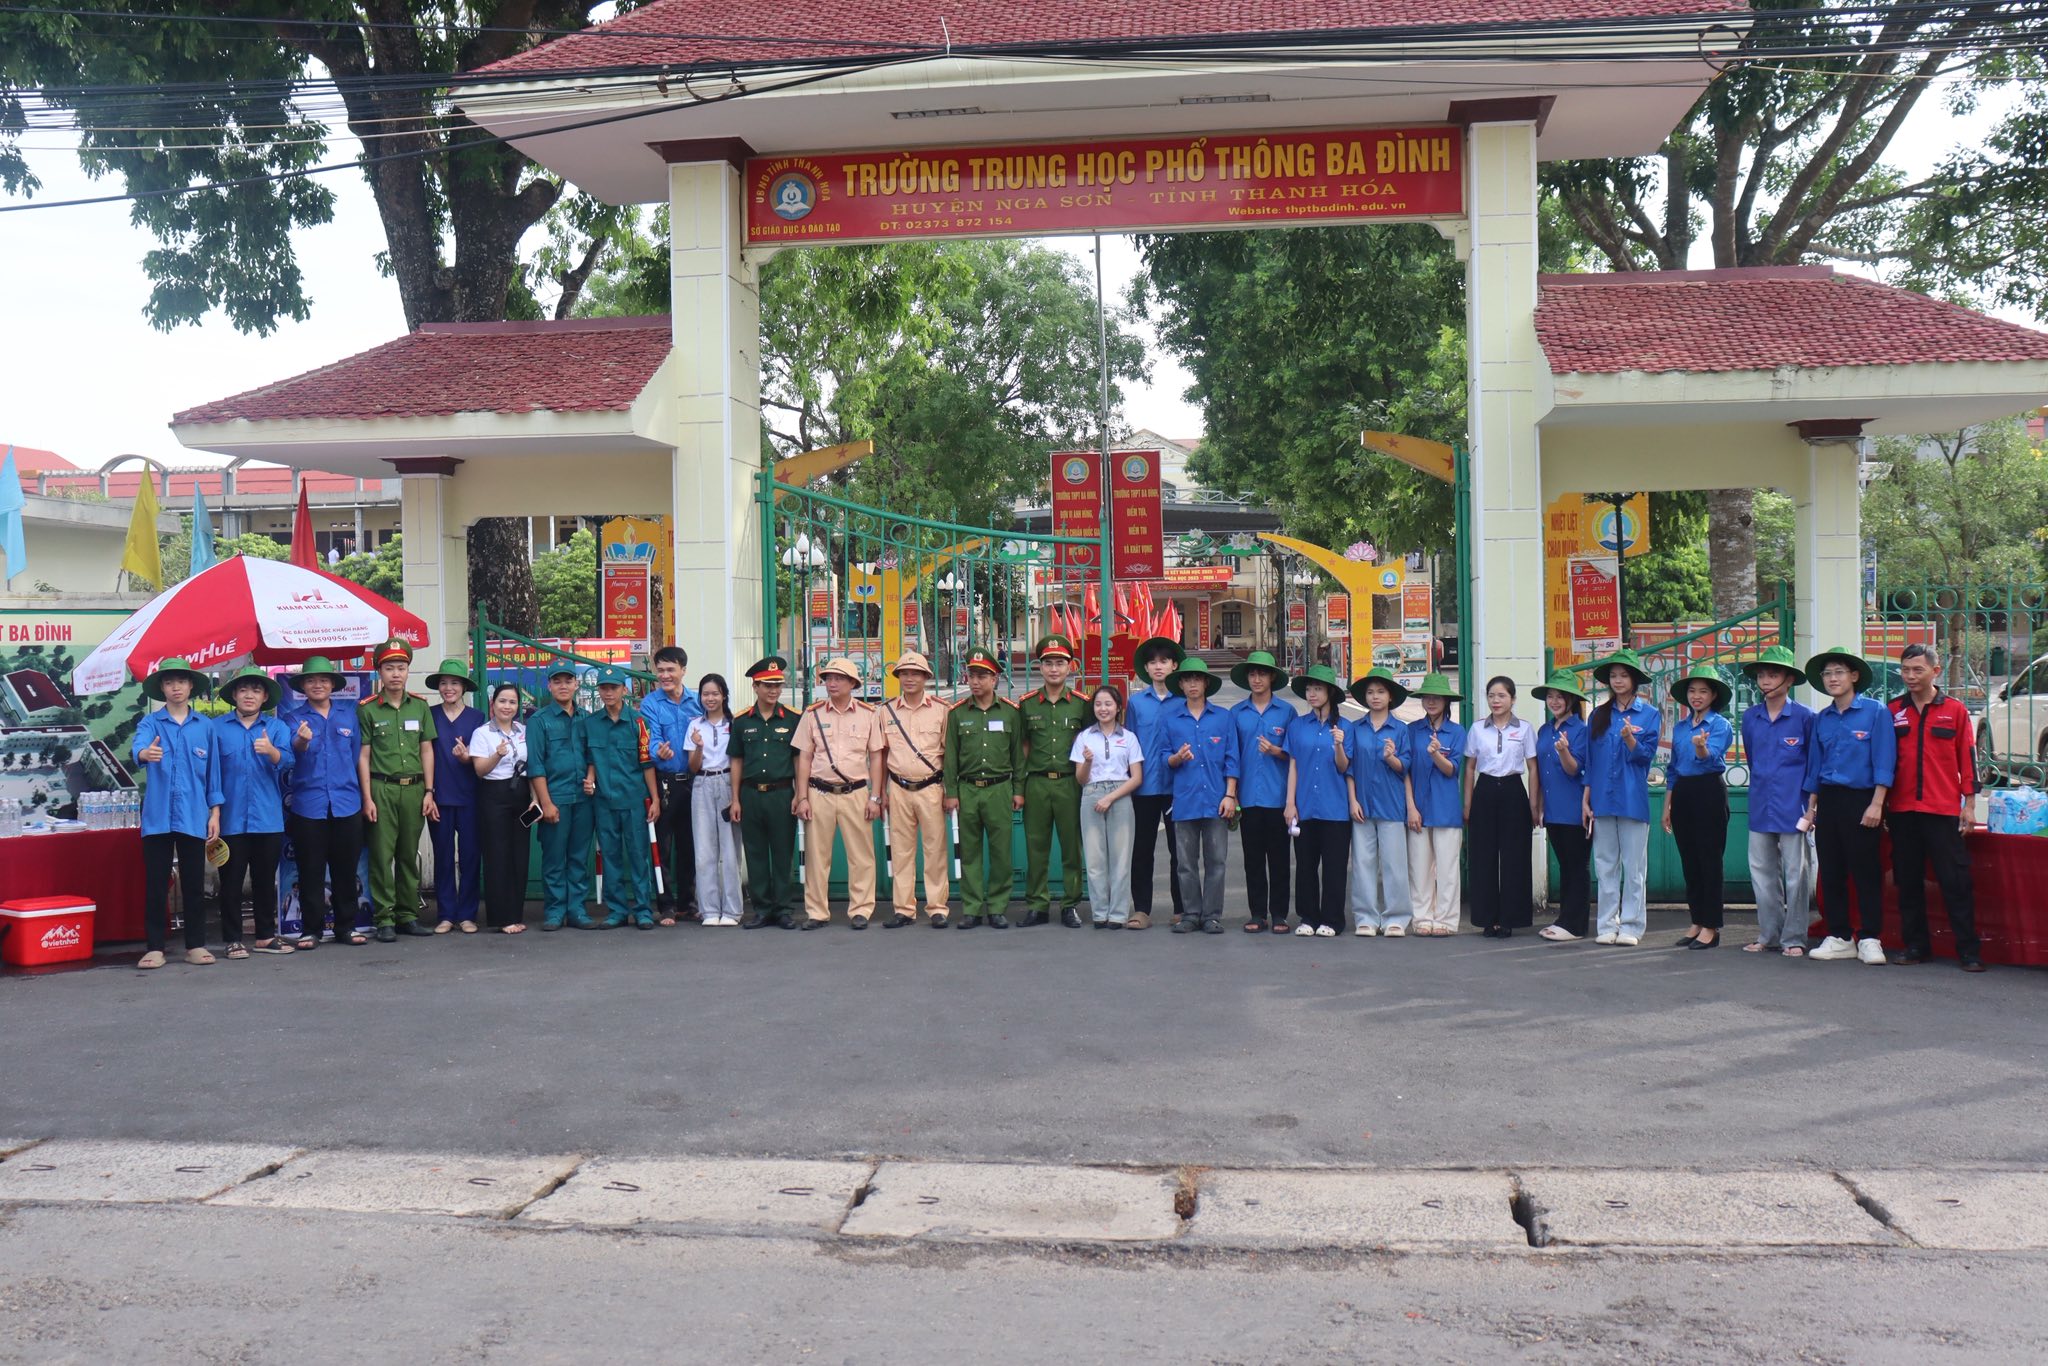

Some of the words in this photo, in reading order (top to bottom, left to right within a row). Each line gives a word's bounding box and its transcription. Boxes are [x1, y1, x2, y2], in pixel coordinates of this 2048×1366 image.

[842, 153, 960, 197] TRƯỜNG
[968, 153, 1067, 191] TRUNG
[1076, 149, 1136, 193] HỌC
[1145, 137, 1208, 184] PHỔ
[1215, 137, 1316, 180] THÔNG
[1326, 141, 1367, 177] BA
[1375, 132, 1450, 174] ĐÌNH
[755, 174, 770, 204] UBND
[794, 158, 824, 180] THANH
[892, 198, 984, 216] HUYỆN
[995, 197, 1048, 211] NGA
[1060, 193, 1113, 208] SƠN
[1150, 186, 1217, 204] TỈNH
[1230, 186, 1328, 201] THANH
[1340, 178, 1397, 197] HÓA
[1228, 206, 1281, 215] Website:
[783, 225, 799, 236] DỤC
[801, 224, 806, 233] &
[826, 223, 840, 235] TẠO
[906, 221, 949, 230] 02373
[956, 218, 982, 227] 872
[988, 217, 1013, 226] 154
[1577, 592, 1595, 606] ĐIỂM
[1597, 596, 1613, 606] HẸN
[1582, 611, 1599, 622] LỊCH
[9, 625, 30, 641] BA
[34, 621, 72, 641] ĐÌNH
[298, 635, 348, 644] 1800599956
[514, 654, 526, 662] BA
[870, 687, 881, 695] 5G
